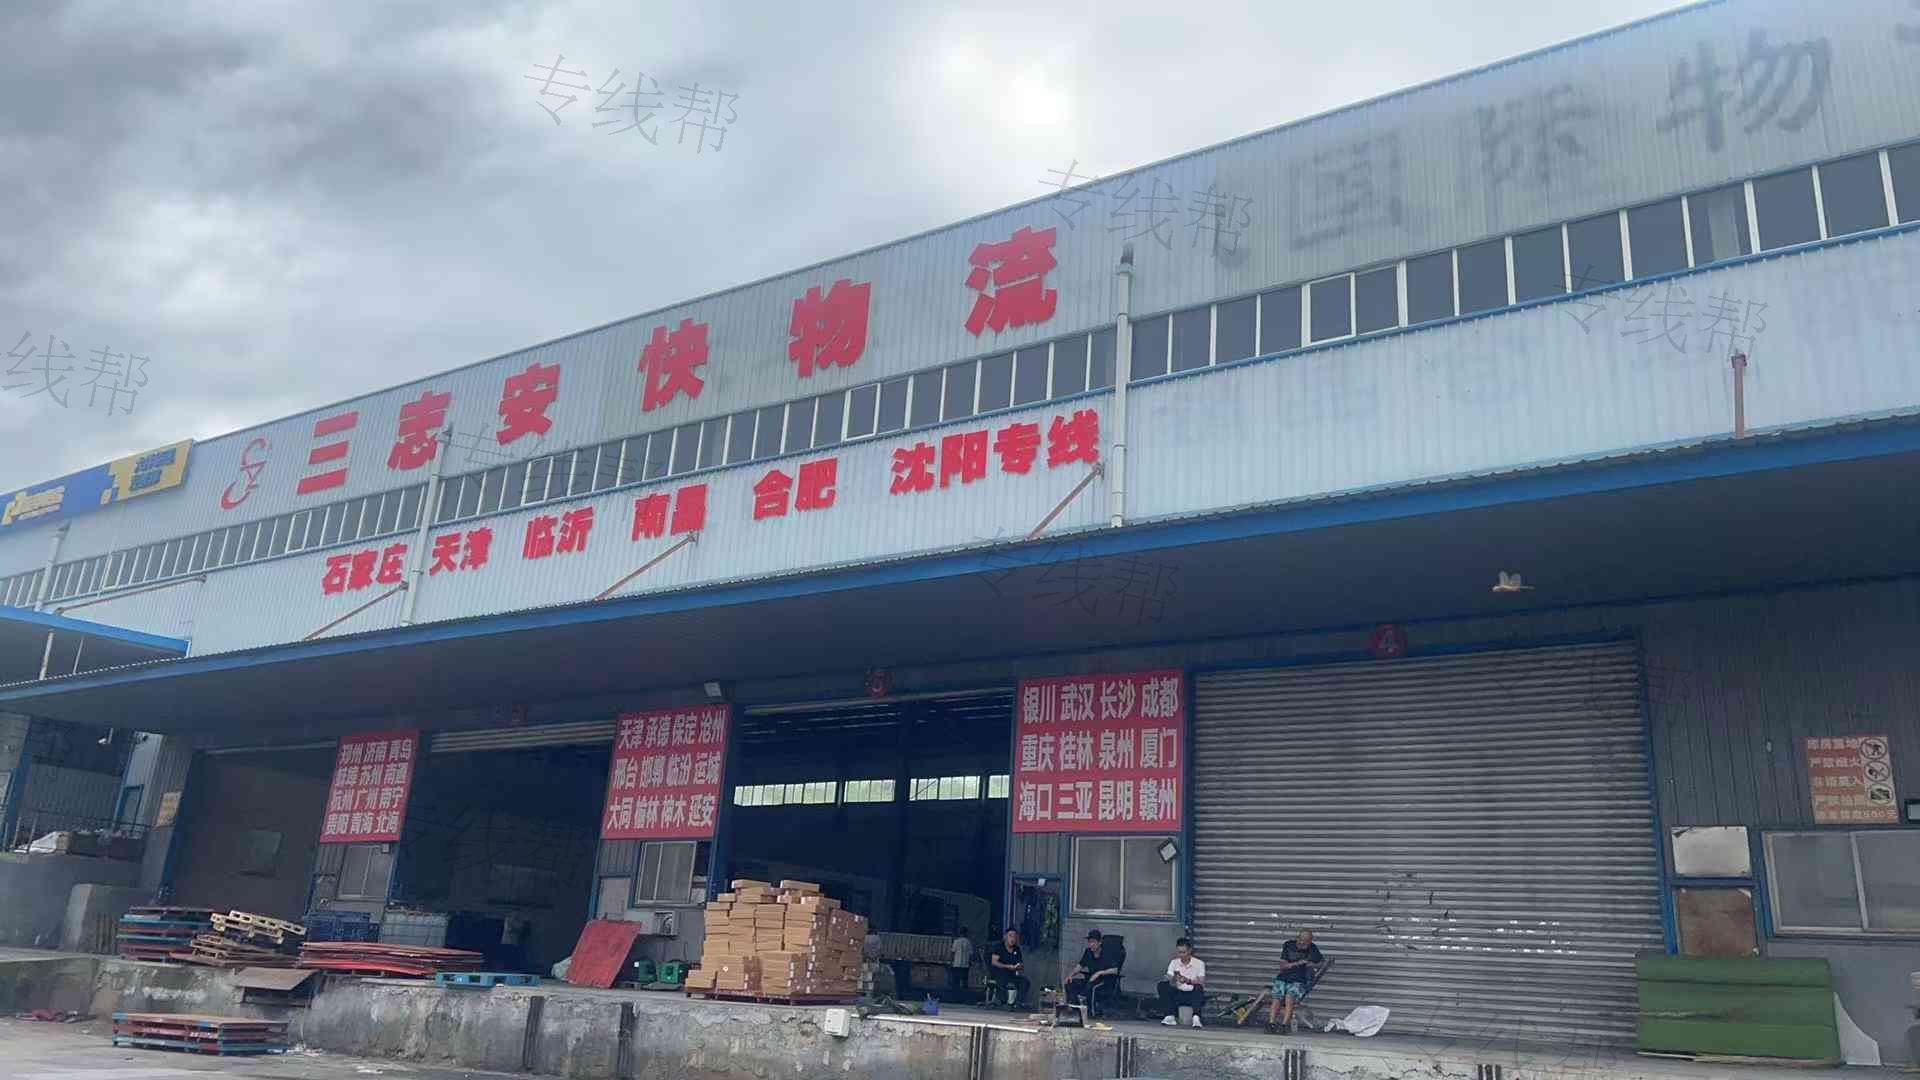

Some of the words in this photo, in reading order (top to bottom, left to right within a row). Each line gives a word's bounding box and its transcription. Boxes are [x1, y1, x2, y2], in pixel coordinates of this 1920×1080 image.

[297, 226, 1058, 495] 三志安快物流
[322, 543, 408, 595] 石家庄
[429, 528, 492, 576] 天津
[523, 507, 594, 559] 临沂
[632, 485, 707, 541] 南昌
[753, 458, 837, 520] 合肥
[890, 409, 1099, 496] 沈阳专线
[1023, 685, 1056, 724] 银川
[1060, 683, 1095, 721] 武汉
[1100, 680, 1136, 720] 长沙
[1141, 677, 1178, 718] 成都
[618, 718, 645, 749] 天津
[644, 715, 671, 749] 承德
[671, 713, 698, 746] 保定
[698, 710, 726, 744] 沧州
[1021, 733, 1055, 772] 重庆
[1059, 730, 1094, 771] 桂林
[1099, 728, 1135, 769] 泉州
[1140, 727, 1177, 769] 厦门
[353, 787, 380, 810] 广州
[607, 796, 635, 830] 大同
[687, 792, 716, 828] 延安
[1018, 781, 1053, 821] 海口
[1057, 781, 1093, 820] 三亚
[1098, 779, 1134, 821] 昆明
[1139, 778, 1177, 821] 赣州
